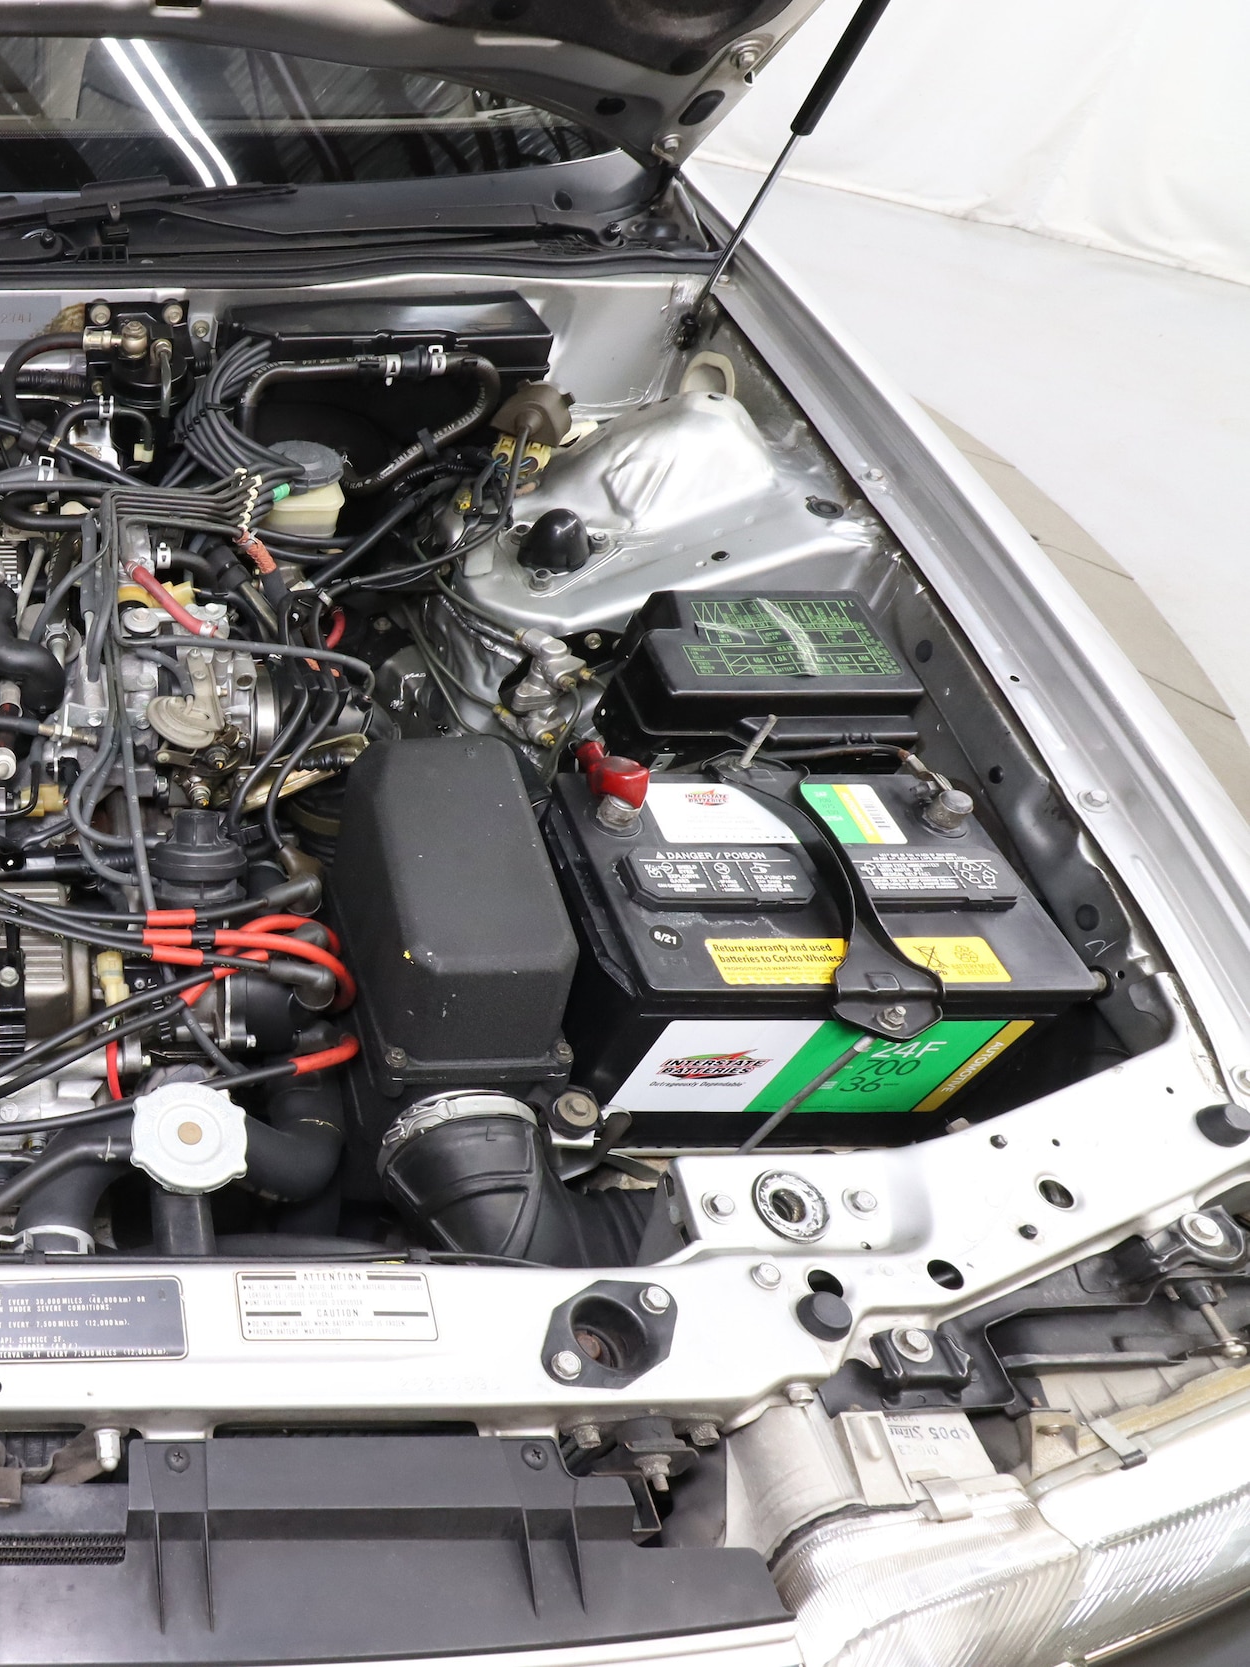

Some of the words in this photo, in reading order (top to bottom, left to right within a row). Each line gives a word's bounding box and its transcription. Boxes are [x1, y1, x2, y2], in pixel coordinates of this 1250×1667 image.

[665, 852, 713, 860] DANGER
[723, 851, 767, 860] POISON
[653, 931, 677, 946] 6/21
[712, 943, 745, 953] Return
[745, 944, 789, 954] warranty
[790, 943, 808, 951] and
[809, 943, 832, 951] used
[717, 954, 760, 963] batteries
[761, 955, 771, 963] to
[772, 954, 803, 963] Costco
[871, 1041, 948, 1058] 24F
[663, 1059, 769, 1068] INTERSTATE
[857, 1059, 921, 1076] 700
[940, 1041, 1004, 1092] AUTOMOTIVE
[659, 1066, 753, 1075] BATTERIES
[649, 1080, 697, 1088] Outrageously
[699, 1080, 743, 1088] Dependable
[839, 1076, 884, 1092] 36
[303, 1273, 362, 1281] ATTENTION
[136, 1295, 146, 1303] OR
[9, 1305, 32, 1313] UNDER
[36, 1304, 62, 1312] SEVERE
[67, 1304, 112, 1312] CONDITIONS.
[316, 1309, 359, 1318] CAUTION
[8, 1321, 30, 1329] EVERY
[46, 1350, 68, 1358] EVERY
